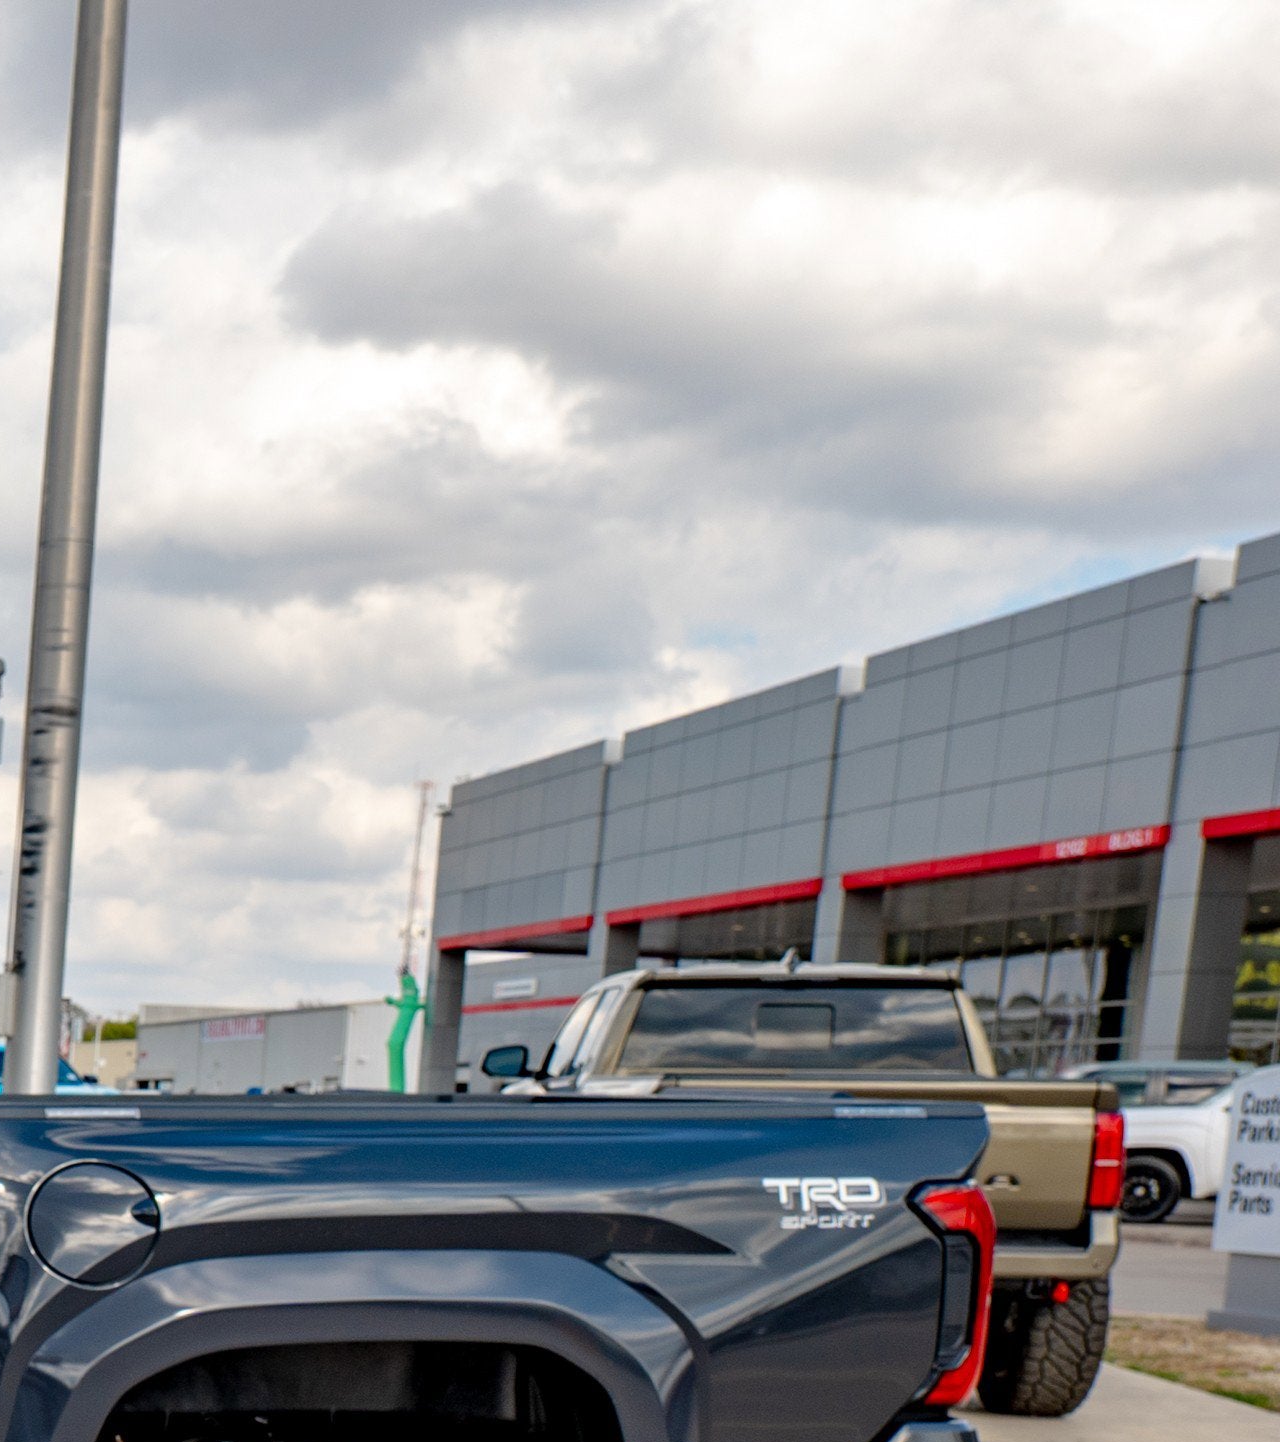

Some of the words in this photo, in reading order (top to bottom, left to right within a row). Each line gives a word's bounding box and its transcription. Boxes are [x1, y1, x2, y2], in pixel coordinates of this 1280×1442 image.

[762, 1176, 882, 1212] TRD
[1228, 1189, 1272, 1215] Parts
[780, 1212, 876, 1230] SPORT
